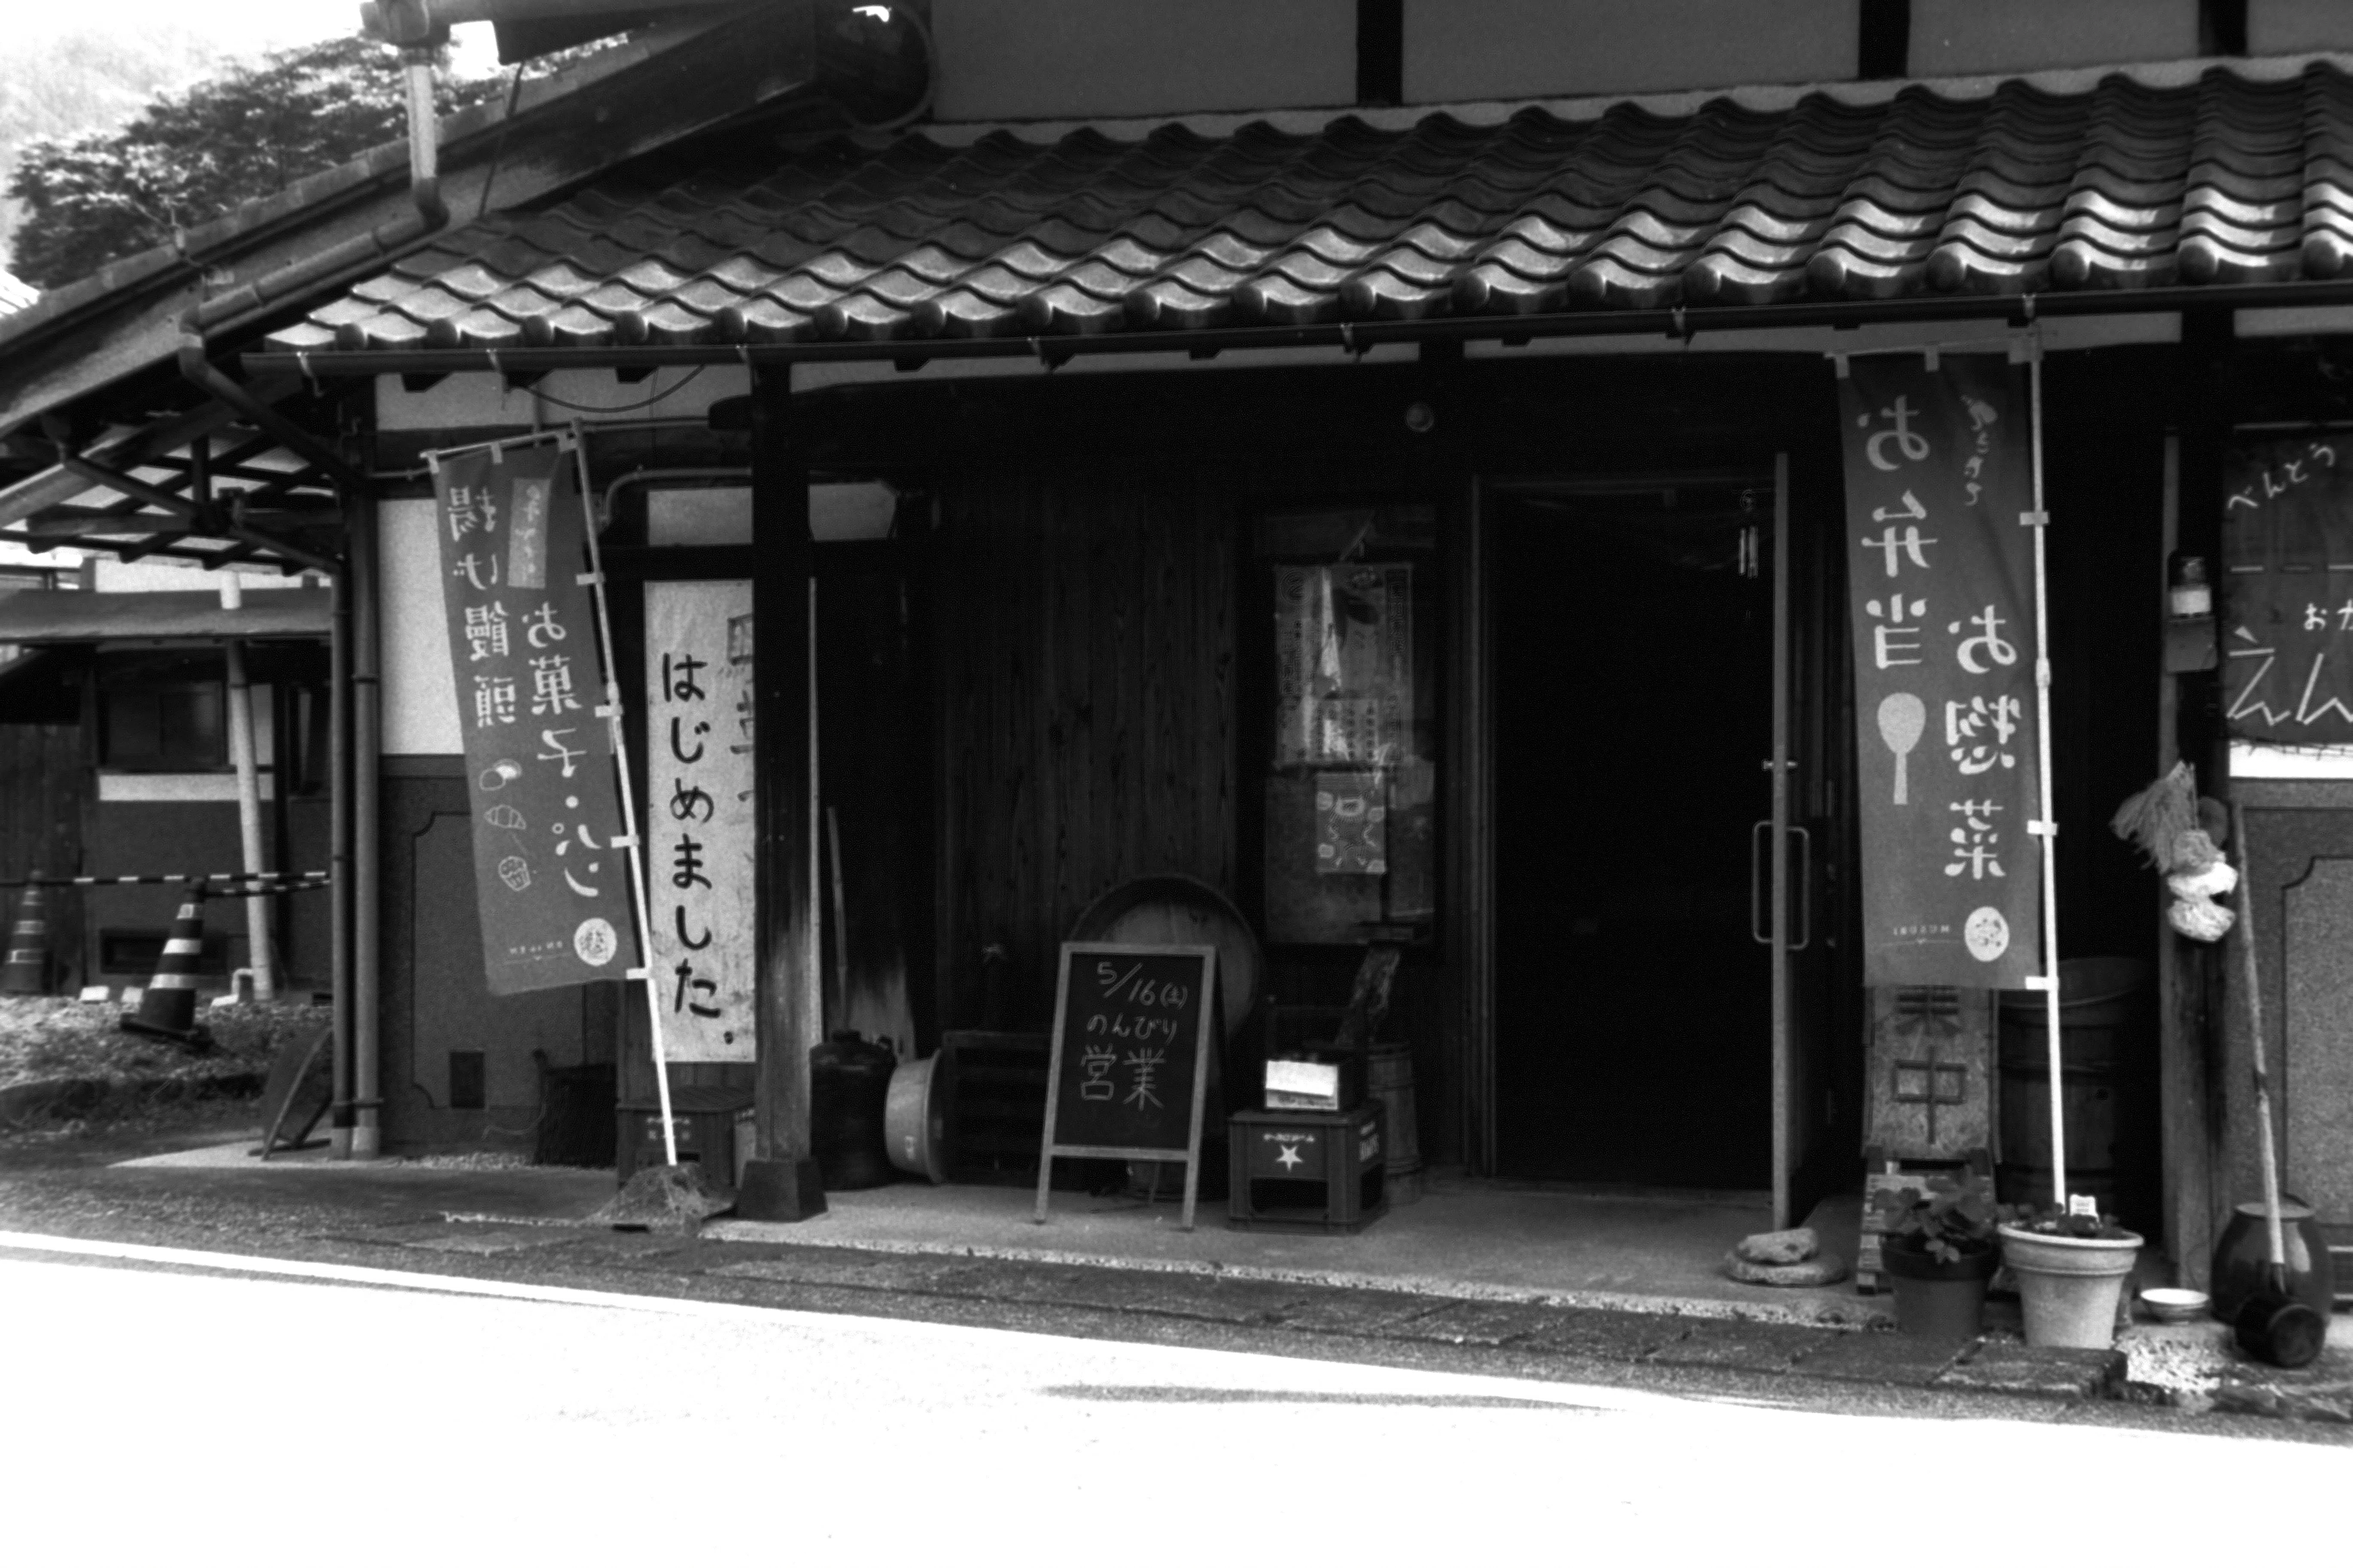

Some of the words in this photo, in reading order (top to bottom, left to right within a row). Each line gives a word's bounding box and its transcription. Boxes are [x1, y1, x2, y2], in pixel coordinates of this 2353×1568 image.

[2227, 443, 2335, 511] べんとう
[1086, 1012, 1178, 1046] のんびり
[1079, 1042, 1167, 1112] 営業
